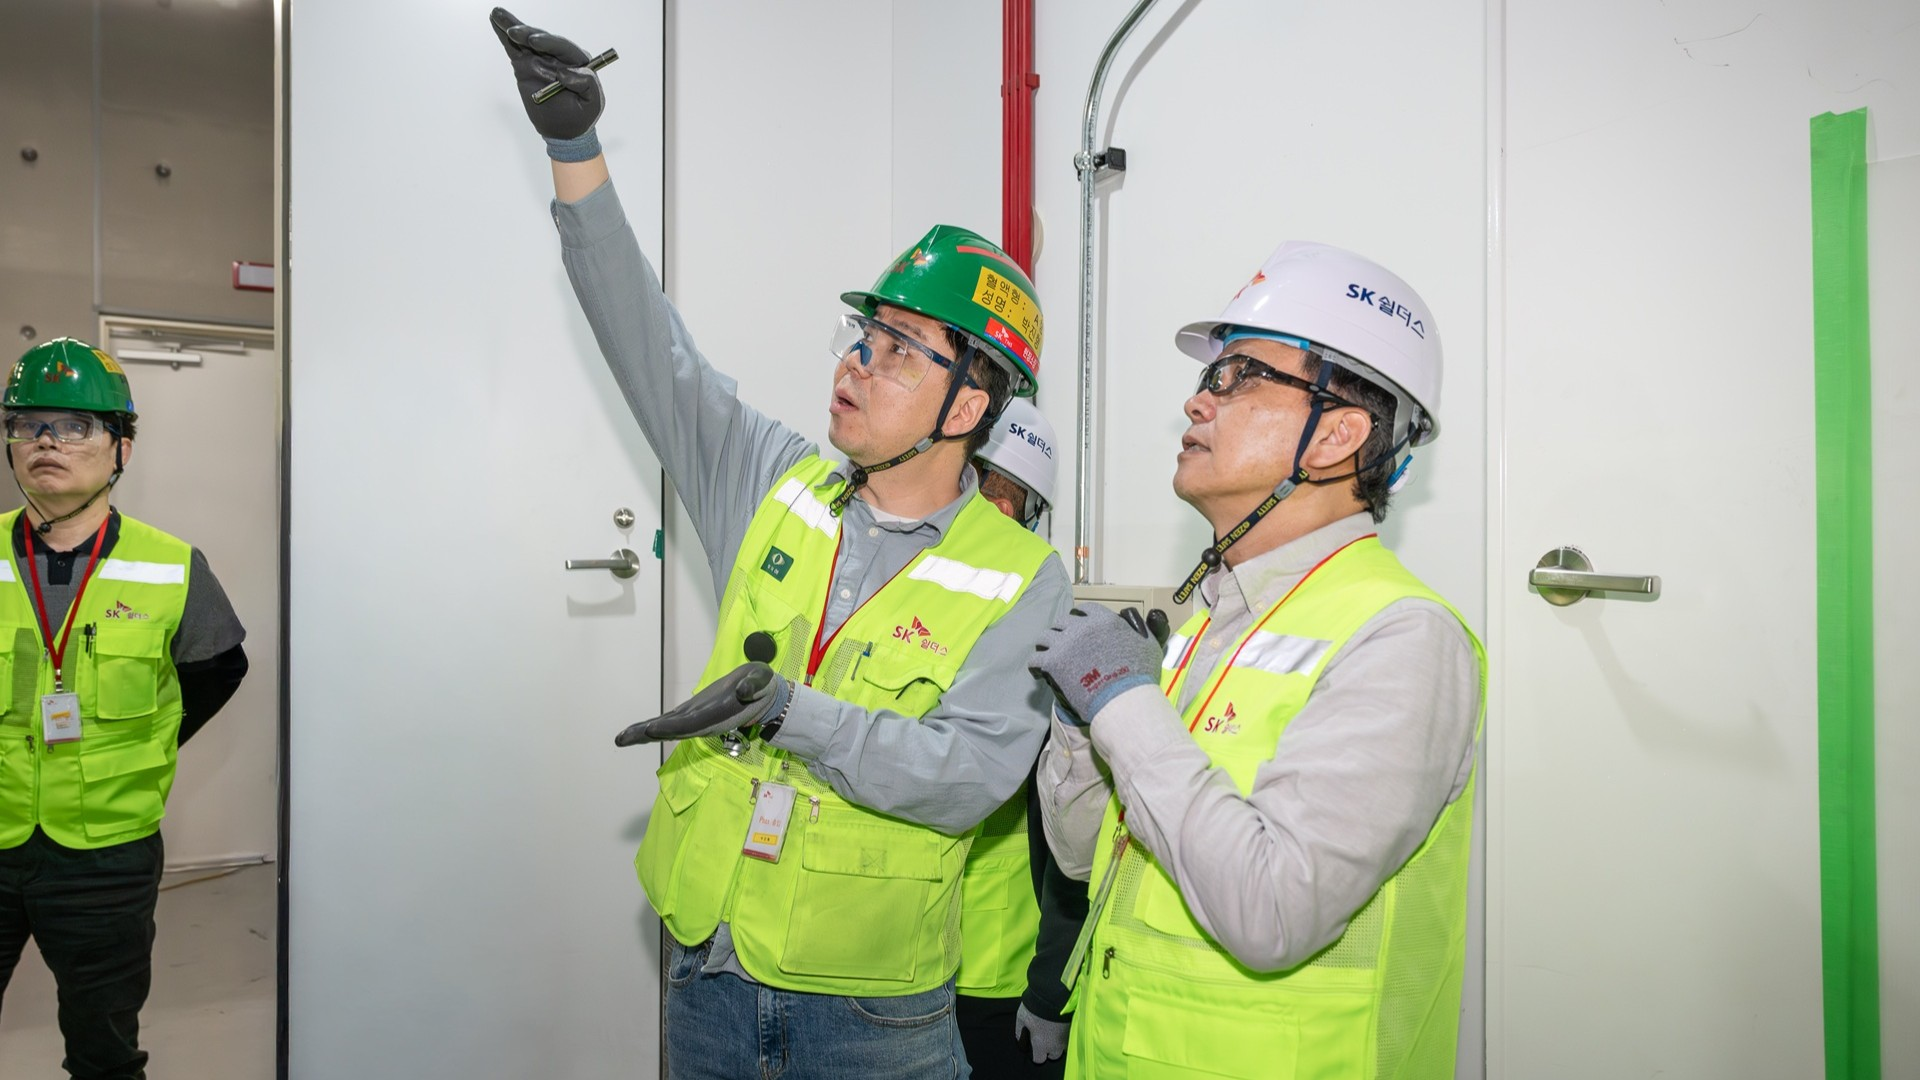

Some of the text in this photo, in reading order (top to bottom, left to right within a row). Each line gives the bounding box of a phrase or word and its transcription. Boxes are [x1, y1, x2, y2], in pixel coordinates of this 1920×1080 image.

[1346, 283, 1425, 340] SK 쉴더스
[1009, 423, 1027, 440] SK
[105, 609, 120, 619] SK
[892, 625, 915, 644] SK
[1080, 668, 1101, 688] 3M
